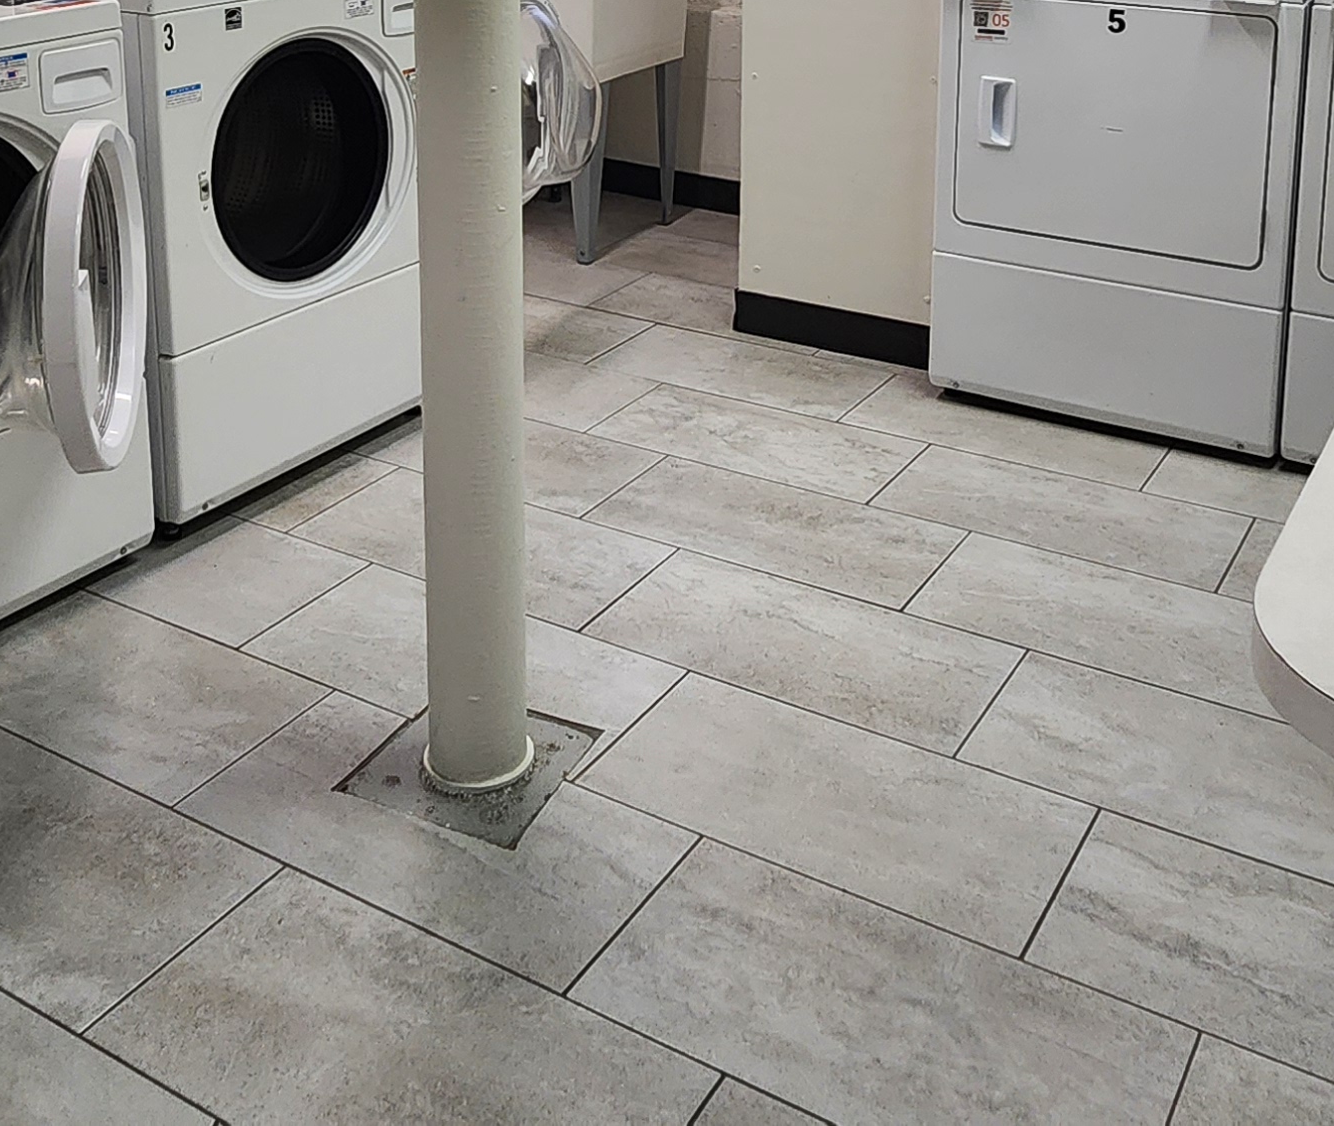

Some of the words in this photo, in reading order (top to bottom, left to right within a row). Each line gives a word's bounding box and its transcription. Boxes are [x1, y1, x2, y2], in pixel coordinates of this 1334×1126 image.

[992, 13, 1010, 27] 05
[1107, 9, 1126, 33] 5
[163, 23, 175, 52] 3
